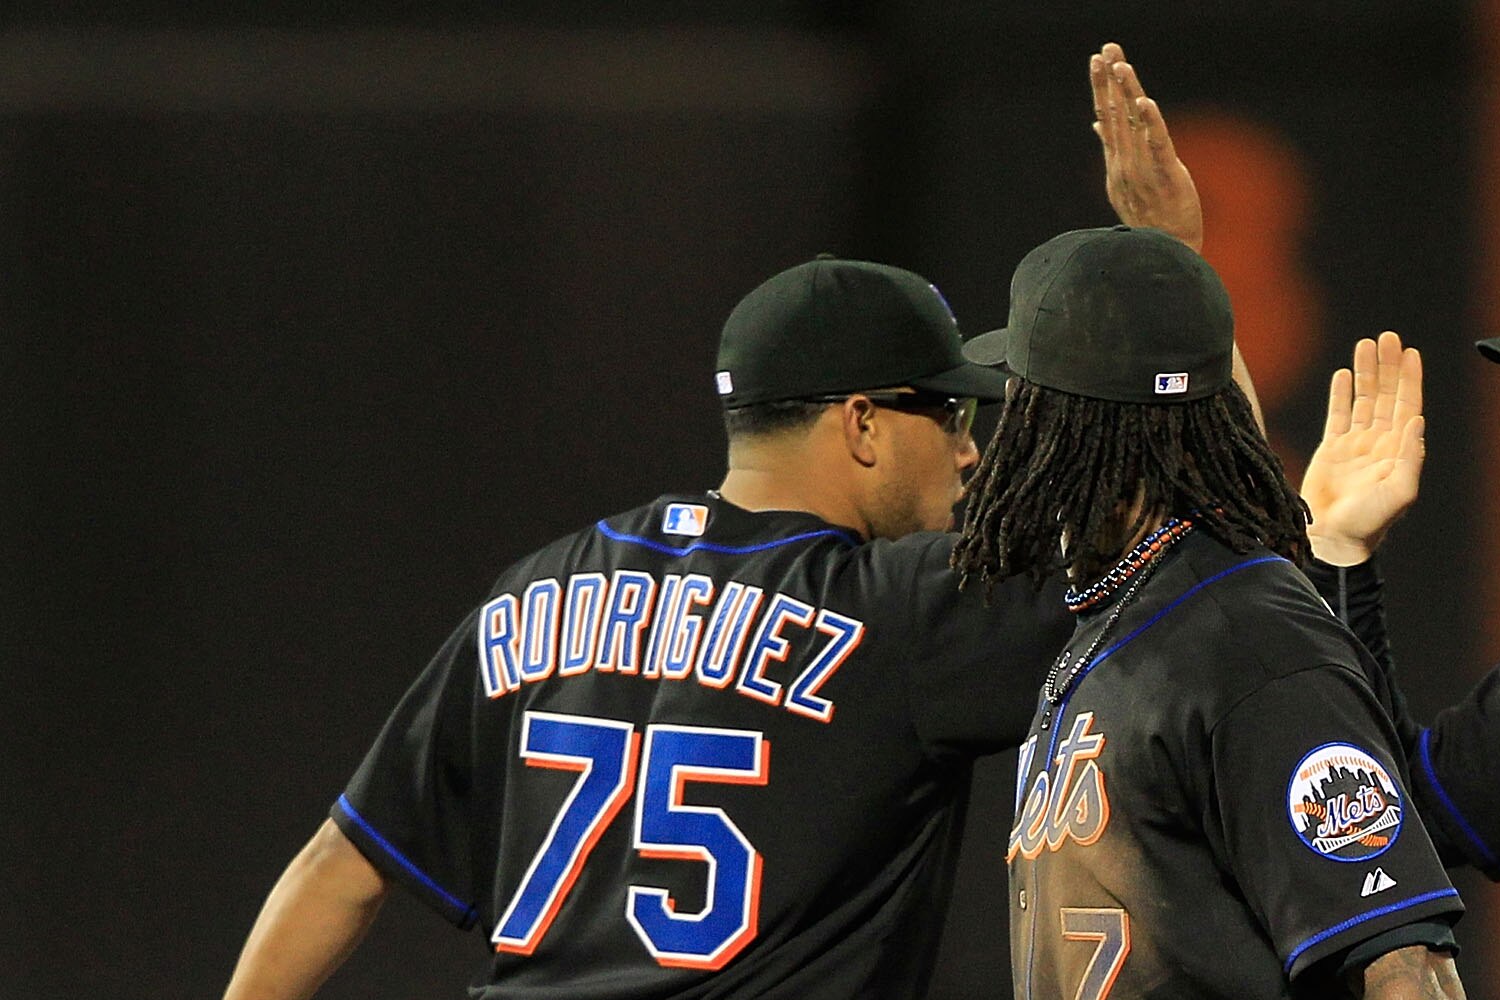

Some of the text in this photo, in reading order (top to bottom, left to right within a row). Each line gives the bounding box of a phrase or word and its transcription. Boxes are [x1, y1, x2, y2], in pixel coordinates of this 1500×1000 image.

[478, 569, 865, 723] RODRIGUEZ
[491, 710, 771, 971] 75
[1316, 784, 1387, 838] Mets
